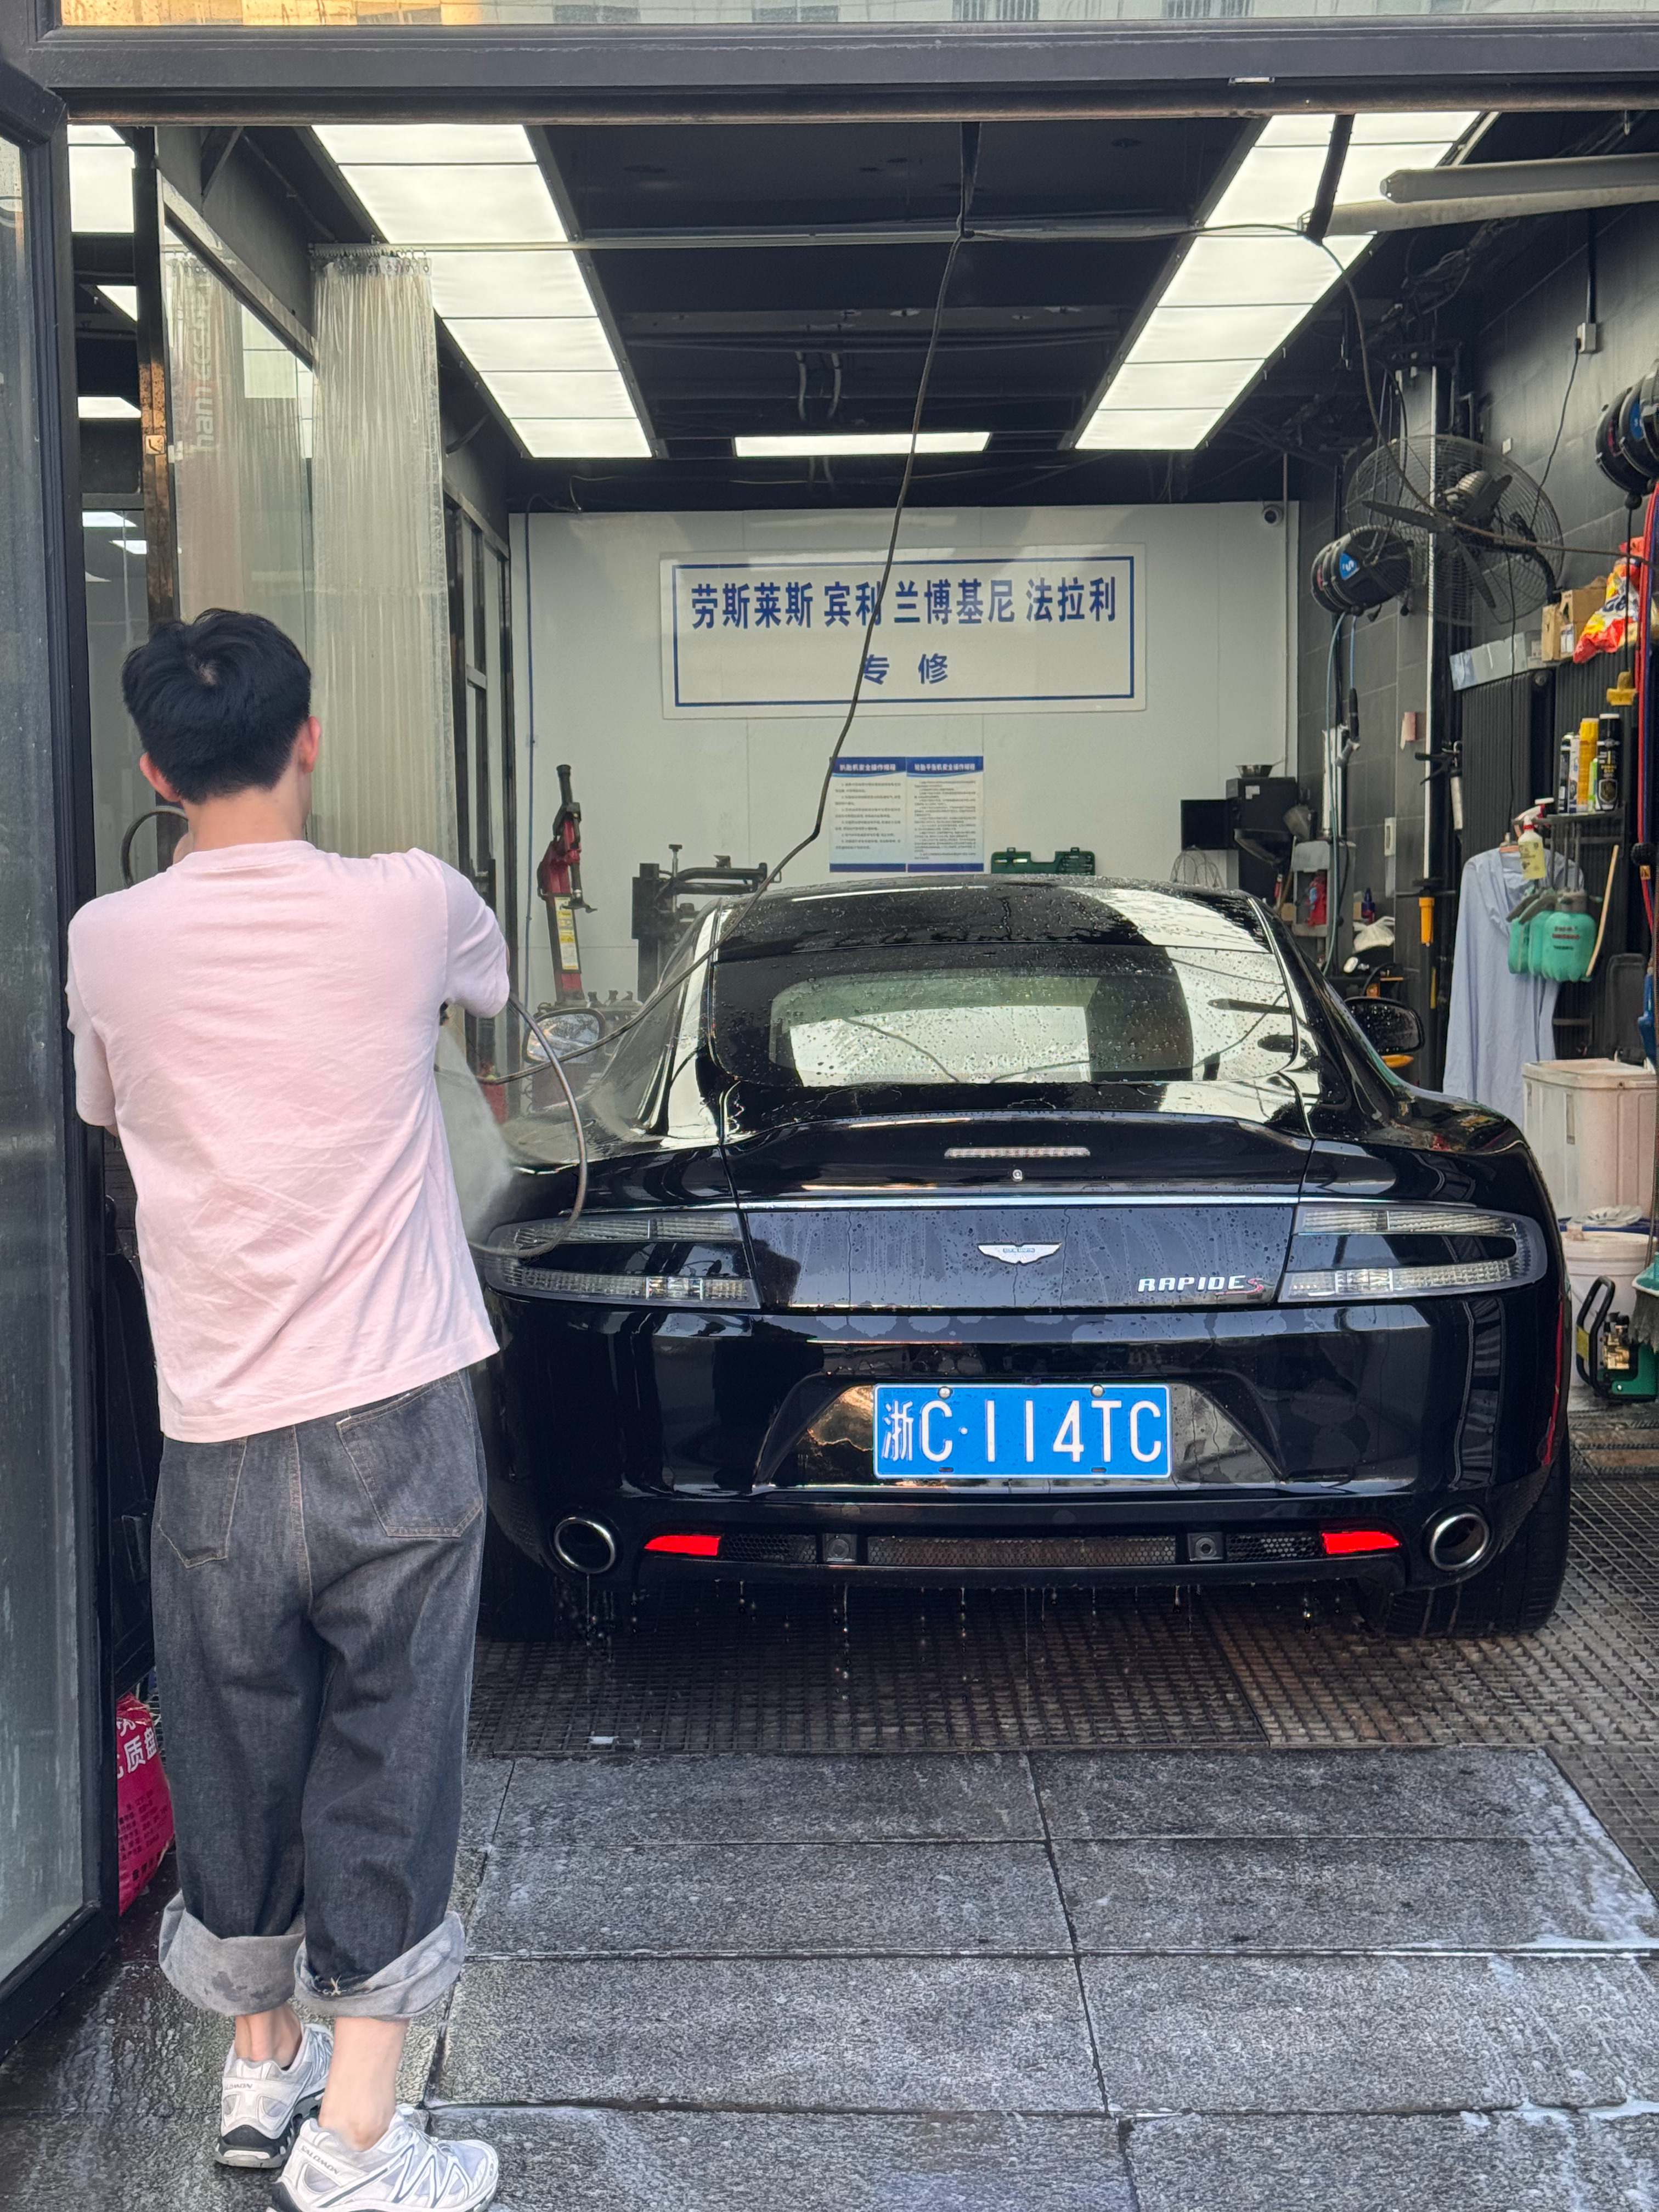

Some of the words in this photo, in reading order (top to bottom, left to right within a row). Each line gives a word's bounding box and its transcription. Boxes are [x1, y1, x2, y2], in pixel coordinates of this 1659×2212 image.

[691, 582, 813, 629] 劳斯莱斯
[824, 580, 881, 627] 宾利
[894, 578, 1015, 624] 兰博基尼
[1026, 576, 1116, 622] 法拉利
[1137, 1275, 1246, 1292] RAPIDE
[301, 2145, 340, 2175] SALOMON
